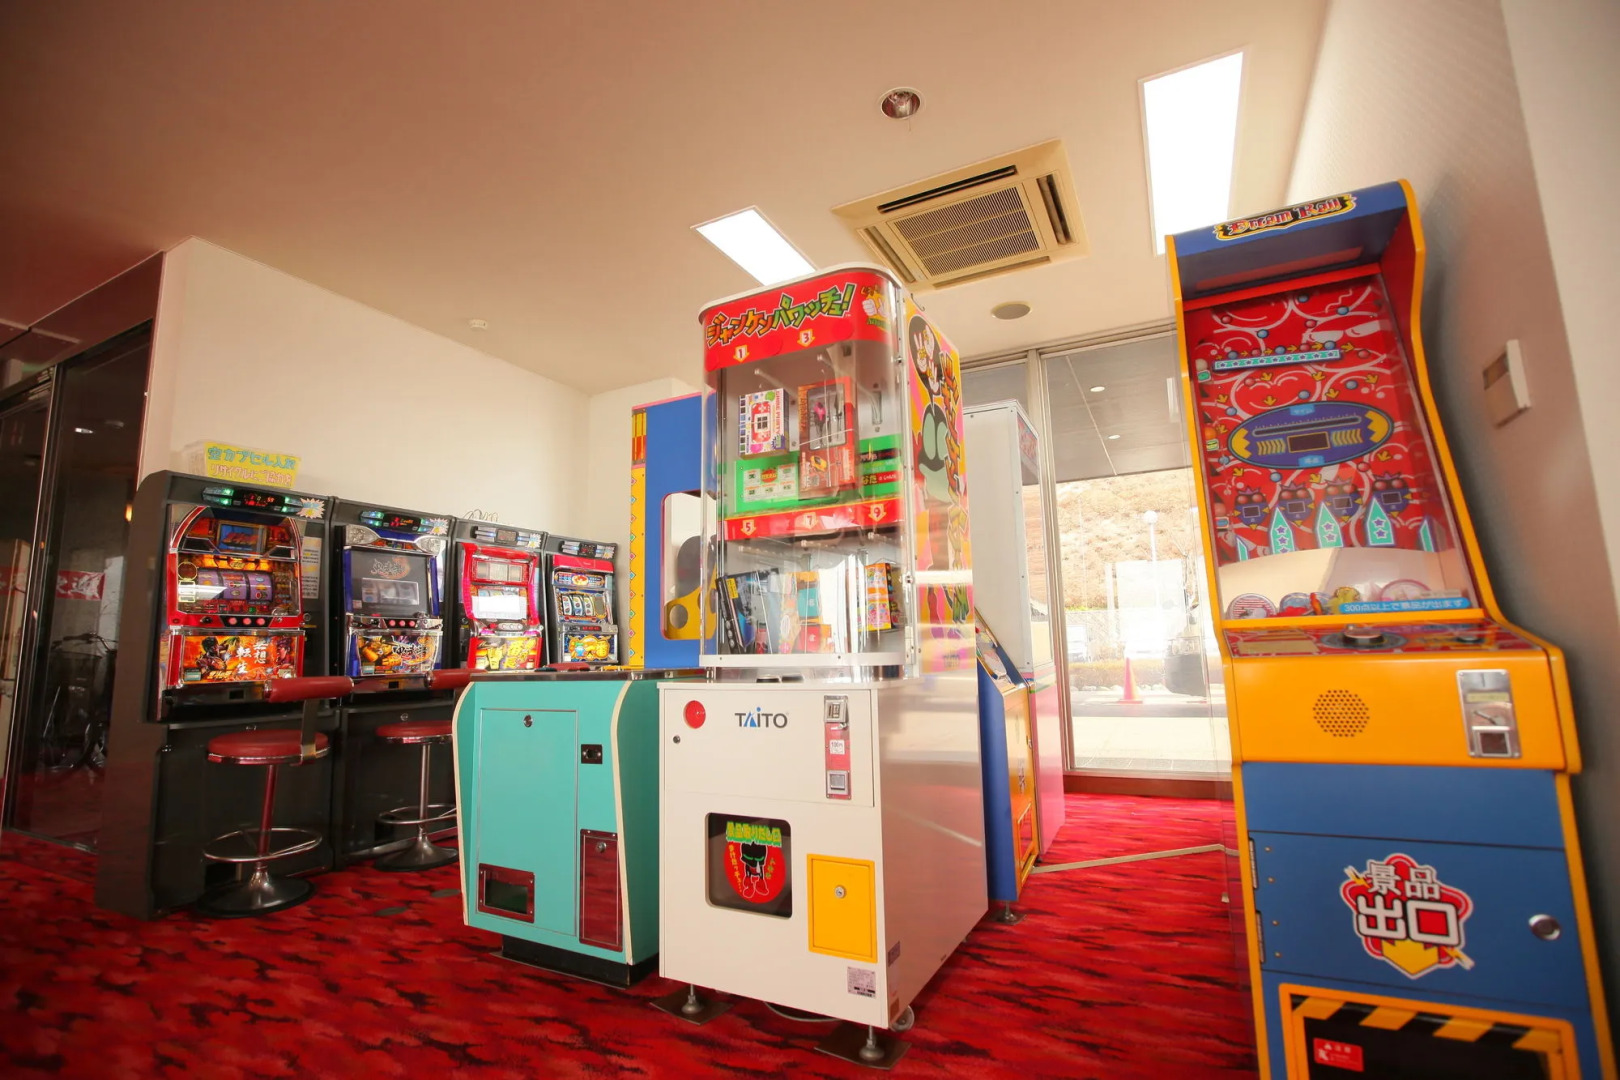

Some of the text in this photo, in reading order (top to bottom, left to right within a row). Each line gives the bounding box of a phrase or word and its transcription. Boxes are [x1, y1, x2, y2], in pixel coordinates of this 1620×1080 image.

[734, 706, 788, 729] TAITO
[1365, 860, 1441, 900] 景品
[1356, 895, 1461, 947] 出口
